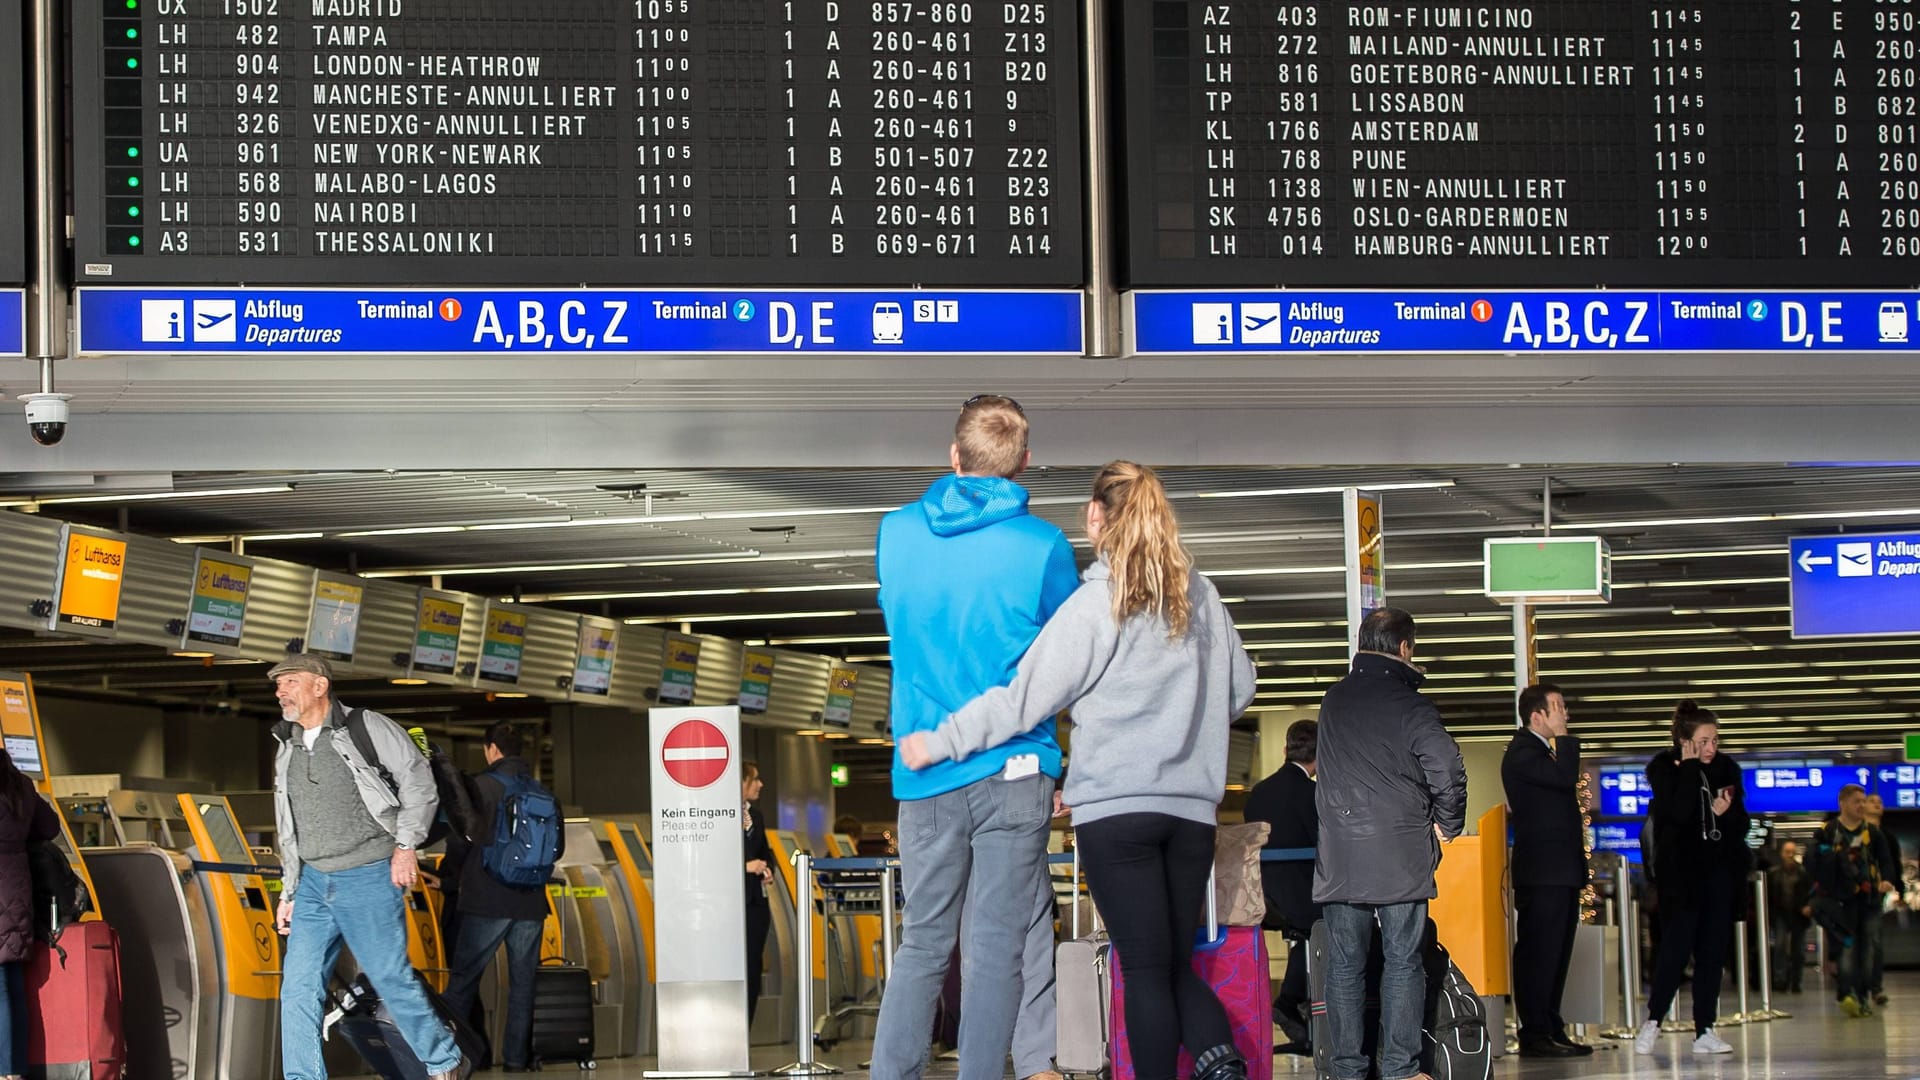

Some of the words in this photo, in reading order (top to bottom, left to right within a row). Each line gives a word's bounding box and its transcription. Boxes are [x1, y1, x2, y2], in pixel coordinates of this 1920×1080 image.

[225, 0, 277, 15] 1502
[313, 0, 401, 16] MADRID
[785, 2, 791, 20] 1
[827, 2, 838, 21] D
[873, 3, 971, 22] 857-860
[1005, 4, 1044, 23] D25
[1204, 6, 1229, 24] AZ
[1278, 7, 1316, 25] 403
[1349, 7, 1531, 28] ROM-FIUMICINO
[1834, 12, 1842, 30] E
[160, 24, 185, 43] LH
[237, 25, 278, 44] 482
[313, 26, 386, 45] TAMPA
[785, 31, 791, 49] 1
[827, 31, 839, 50] A
[873, 32, 969, 51] 260-461
[1005, 33, 1045, 52] Z13
[1206, 35, 1230, 53] LH
[1279, 35, 1317, 54] 272
[1350, 36, 1604, 56] MAILAND-ANNULLIERT
[1834, 40, 1845, 58] A
[160, 54, 186, 73] LH
[237, 55, 278, 74] 904
[315, 55, 539, 76] LONDON-HEATHROW
[786, 60, 792, 78] 1
[828, 60, 840, 78] A
[873, 61, 970, 80] 260-461
[1006, 62, 1045, 81] B20
[1207, 63, 1231, 82] LH
[1279, 64, 1317, 83] 816
[1351, 64, 1633, 85] GOETEBORG-ANNULLIERT
[1835, 68, 1846, 86] A
[160, 84, 186, 103] LH
[237, 84, 278, 103] 942
[314, 85, 616, 106] MANCHESTE-ANNULLIERT
[787, 89, 793, 107] 1
[829, 89, 841, 107] A
[874, 89, 970, 109] 260-461
[1007, 91, 1016, 109] 9
[1206, 92, 1231, 110] TP
[1281, 93, 1317, 111] 581
[1353, 93, 1463, 112] LISSABON
[1836, 97, 1846, 114] B
[161, 113, 186, 132] LH
[238, 114, 278, 133] 326
[313, 114, 585, 135] VENEDXG-ANNULLIERT
[787, 118, 793, 136] 1
[829, 118, 841, 136] A
[875, 118, 971, 138] 260-461
[1009, 119, 1016, 131] 9
[1207, 121, 1231, 139] KL
[1268, 121, 1319, 140] 1766
[1352, 122, 1478, 141] AMSTERDAM
[1836, 125, 1846, 143] D
[160, 143, 188, 162] UA
[238, 143, 277, 163] 961
[315, 144, 357, 163] NEW
[377, 144, 541, 164] YORK-NEWARK
[788, 147, 794, 165] 1
[830, 147, 841, 166] B
[876, 148, 973, 167] 501-507
[1008, 149, 1047, 167] Z22
[1209, 150, 1233, 168] LH
[1281, 150, 1319, 169] 768
[1353, 150, 1406, 169] PUNE
[1837, 153, 1848, 171] A
[161, 172, 187, 192] LH
[239, 173, 279, 192] 568
[315, 173, 495, 193] MALABO-LAGOS
[789, 176, 795, 194] 1
[830, 176, 842, 195] A
[876, 177, 973, 196] 260-461
[1009, 177, 1048, 196] B23
[1210, 178, 1234, 197] LH
[1353, 179, 1565, 198] WIEN-ANNULLIERT
[1838, 181, 1849, 199] A
[162, 202, 187, 221] LH
[239, 202, 280, 222] 590
[315, 203, 415, 222] NAIROBI
[789, 205, 795, 224] 1
[831, 205, 843, 224] A
[877, 206, 973, 225] 260-461
[1010, 206, 1047, 225] B61
[1210, 207, 1235, 226] SK
[1268, 207, 1321, 226] 4756
[1354, 207, 1567, 226] OSLO-GARDERMOEN
[1839, 209, 1849, 227] A
[160, 232, 187, 251] A3
[240, 232, 278, 251] 531
[316, 232, 492, 252] THESSALONIKI
[790, 234, 796, 253] 1
[833, 234, 843, 253] B
[878, 235, 974, 254] 669-671
[1010, 236, 1050, 254] A14
[1211, 235, 1235, 254] LH
[1284, 236, 1322, 254] 014
[1355, 236, 1609, 255] HAMBURG-ANNULLIERT
[1840, 237, 1851, 255] A
[244, 300, 303, 321] Abflug
[358, 301, 433, 318] Terminal
[446, 302, 455, 319] 1
[653, 301, 726, 319] Terminal
[739, 302, 749, 319] 2
[1288, 303, 1343, 323] Abflug
[1394, 302, 1465, 319] Terminal
[1478, 304, 1484, 318] 1
[1671, 301, 1741, 318] Terminal
[1753, 302, 1762, 317] 2
[245, 325, 342, 344] Departures
[1290, 327, 1380, 347] Departures
[1877, 541, 1920, 558] Abflug
[1878, 561, 1920, 578] Depar
[662, 809, 685, 818] Kein
[690, 808, 735, 818] Eingang
[662, 821, 697, 830] Please
[700, 821, 714, 829] do
[663, 834, 678, 843] not
[682, 833, 708, 842] enter
